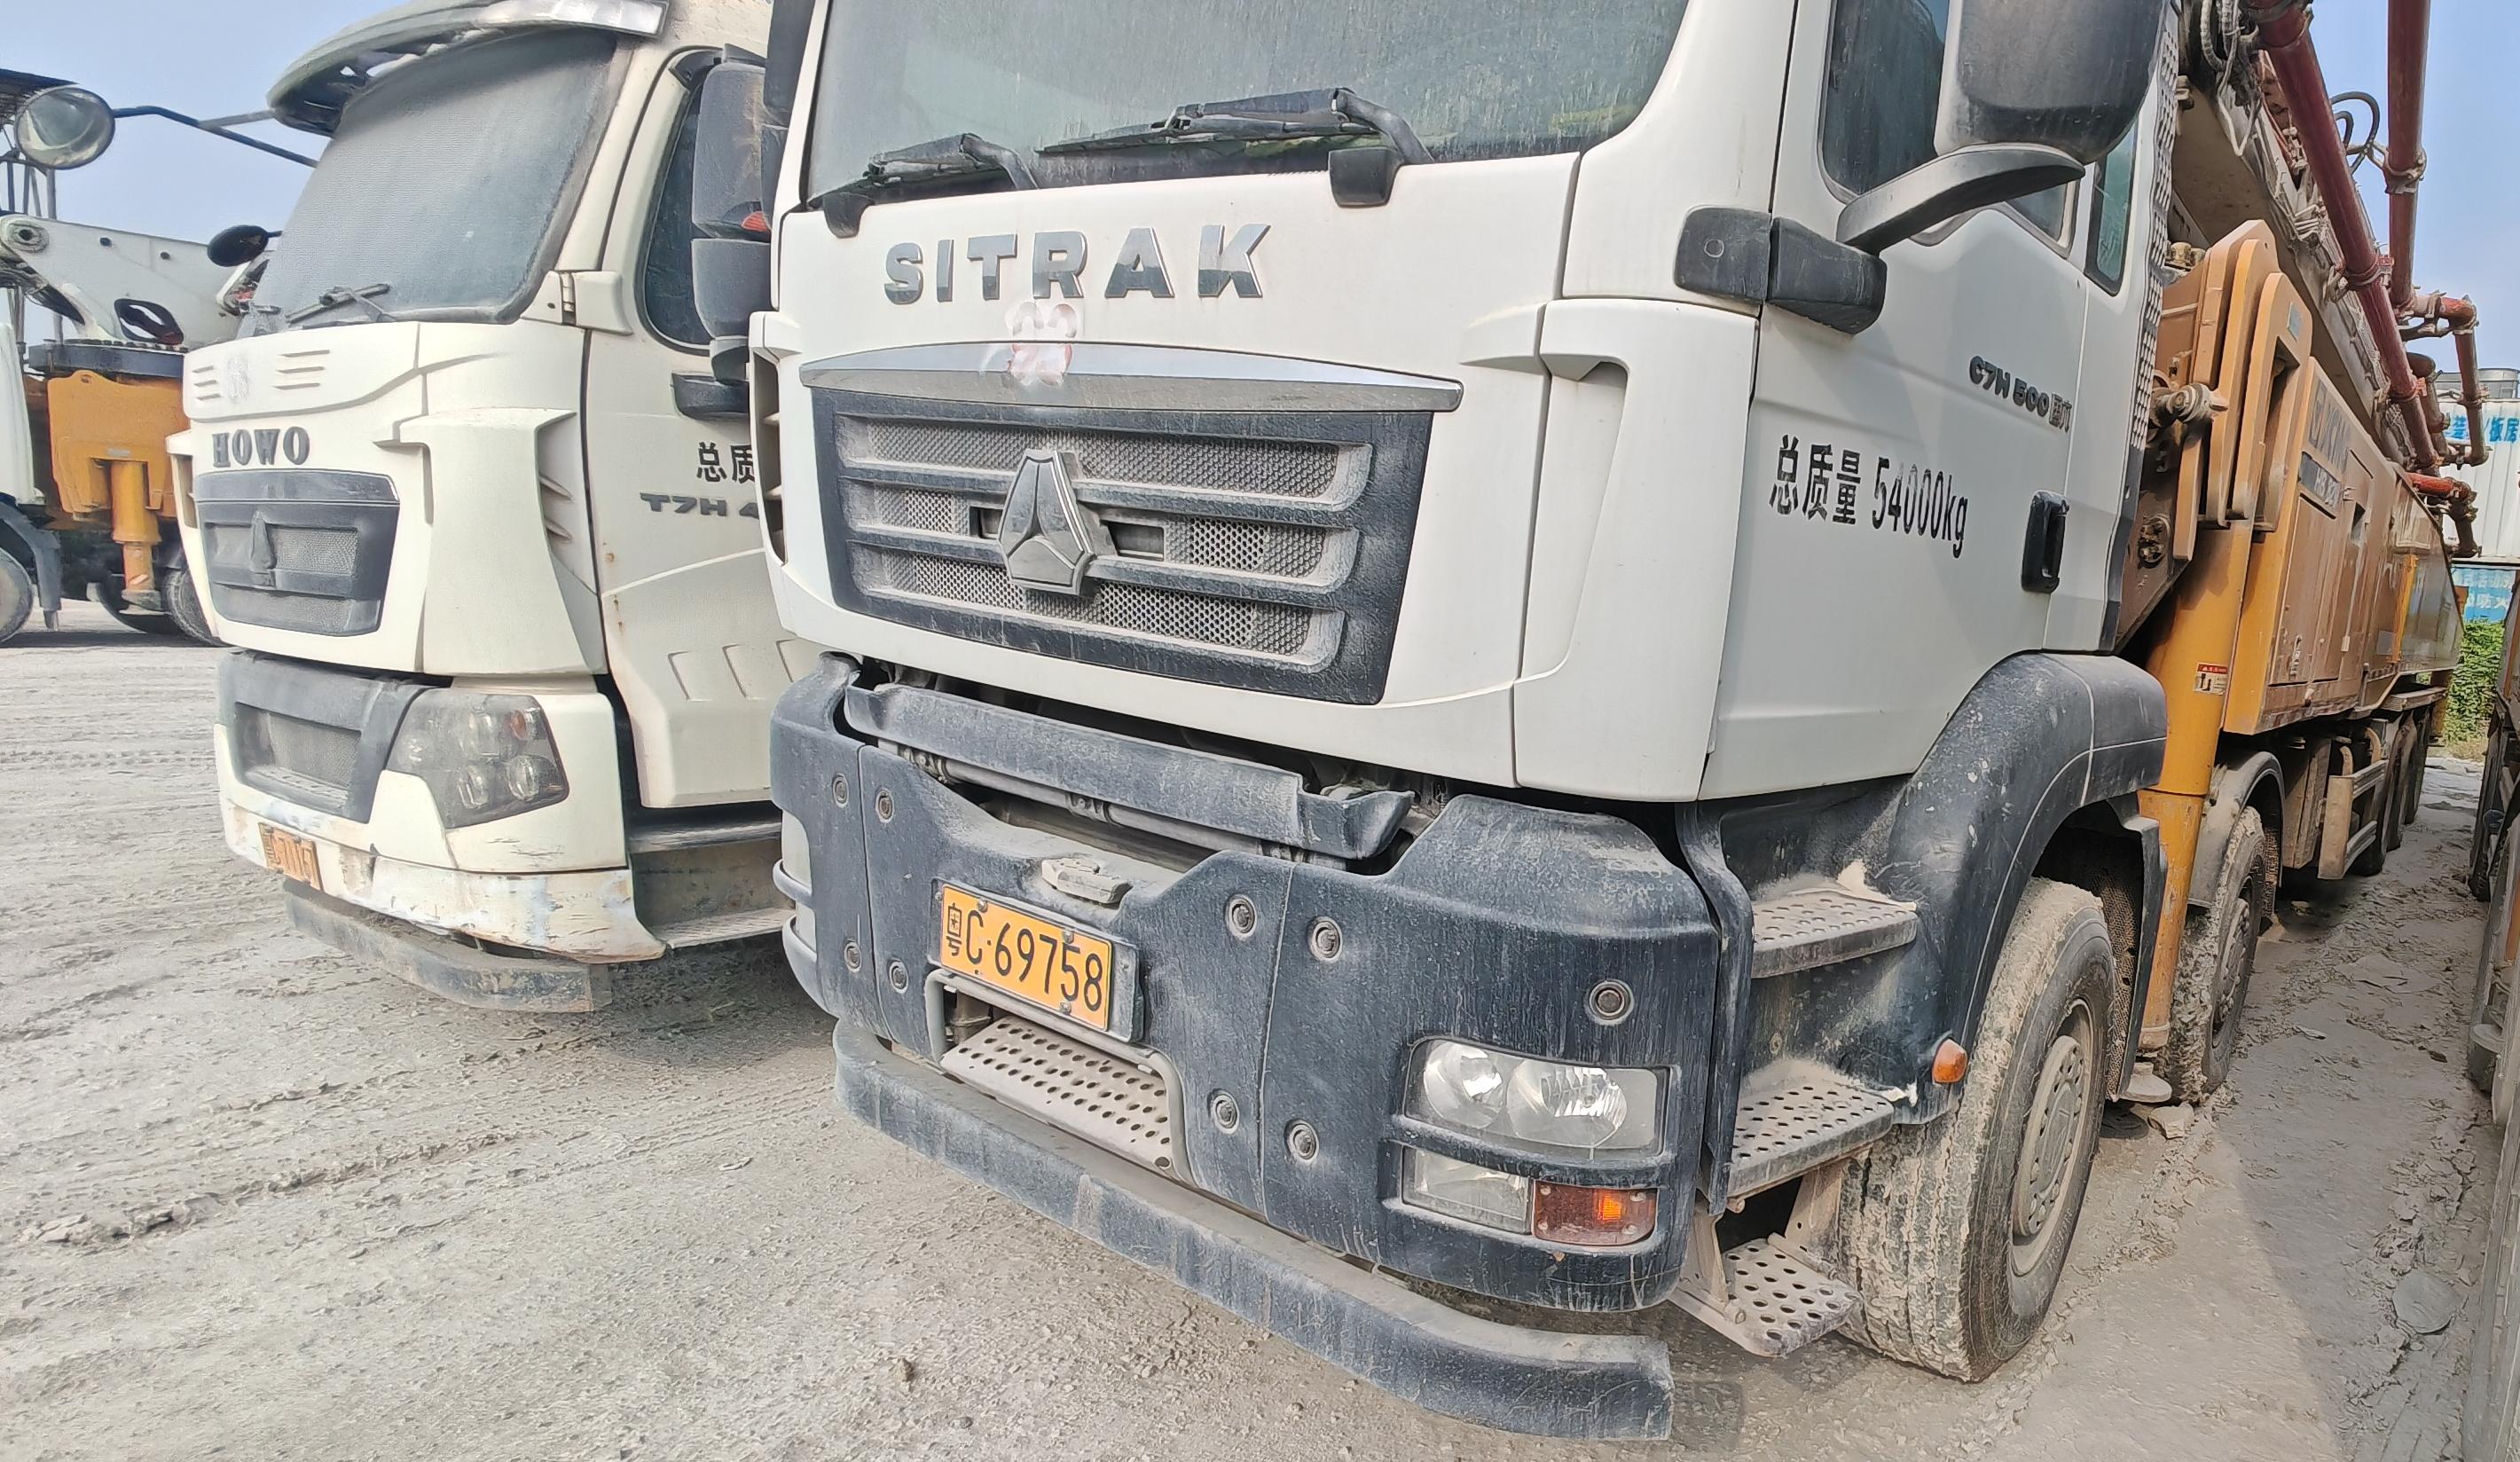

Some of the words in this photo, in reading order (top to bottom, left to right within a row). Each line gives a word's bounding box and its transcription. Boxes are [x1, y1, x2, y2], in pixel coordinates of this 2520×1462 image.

[884, 224, 1271, 305] SITRAK
[1969, 356, 2011, 398] C7H
[212, 426, 310, 468] HOWO
[696, 442, 756, 483] 总质
[640, 492, 727, 516] T7H
[1769, 434, 1861, 524] 总质量
[1872, 457, 1968, 558] 54000kg
